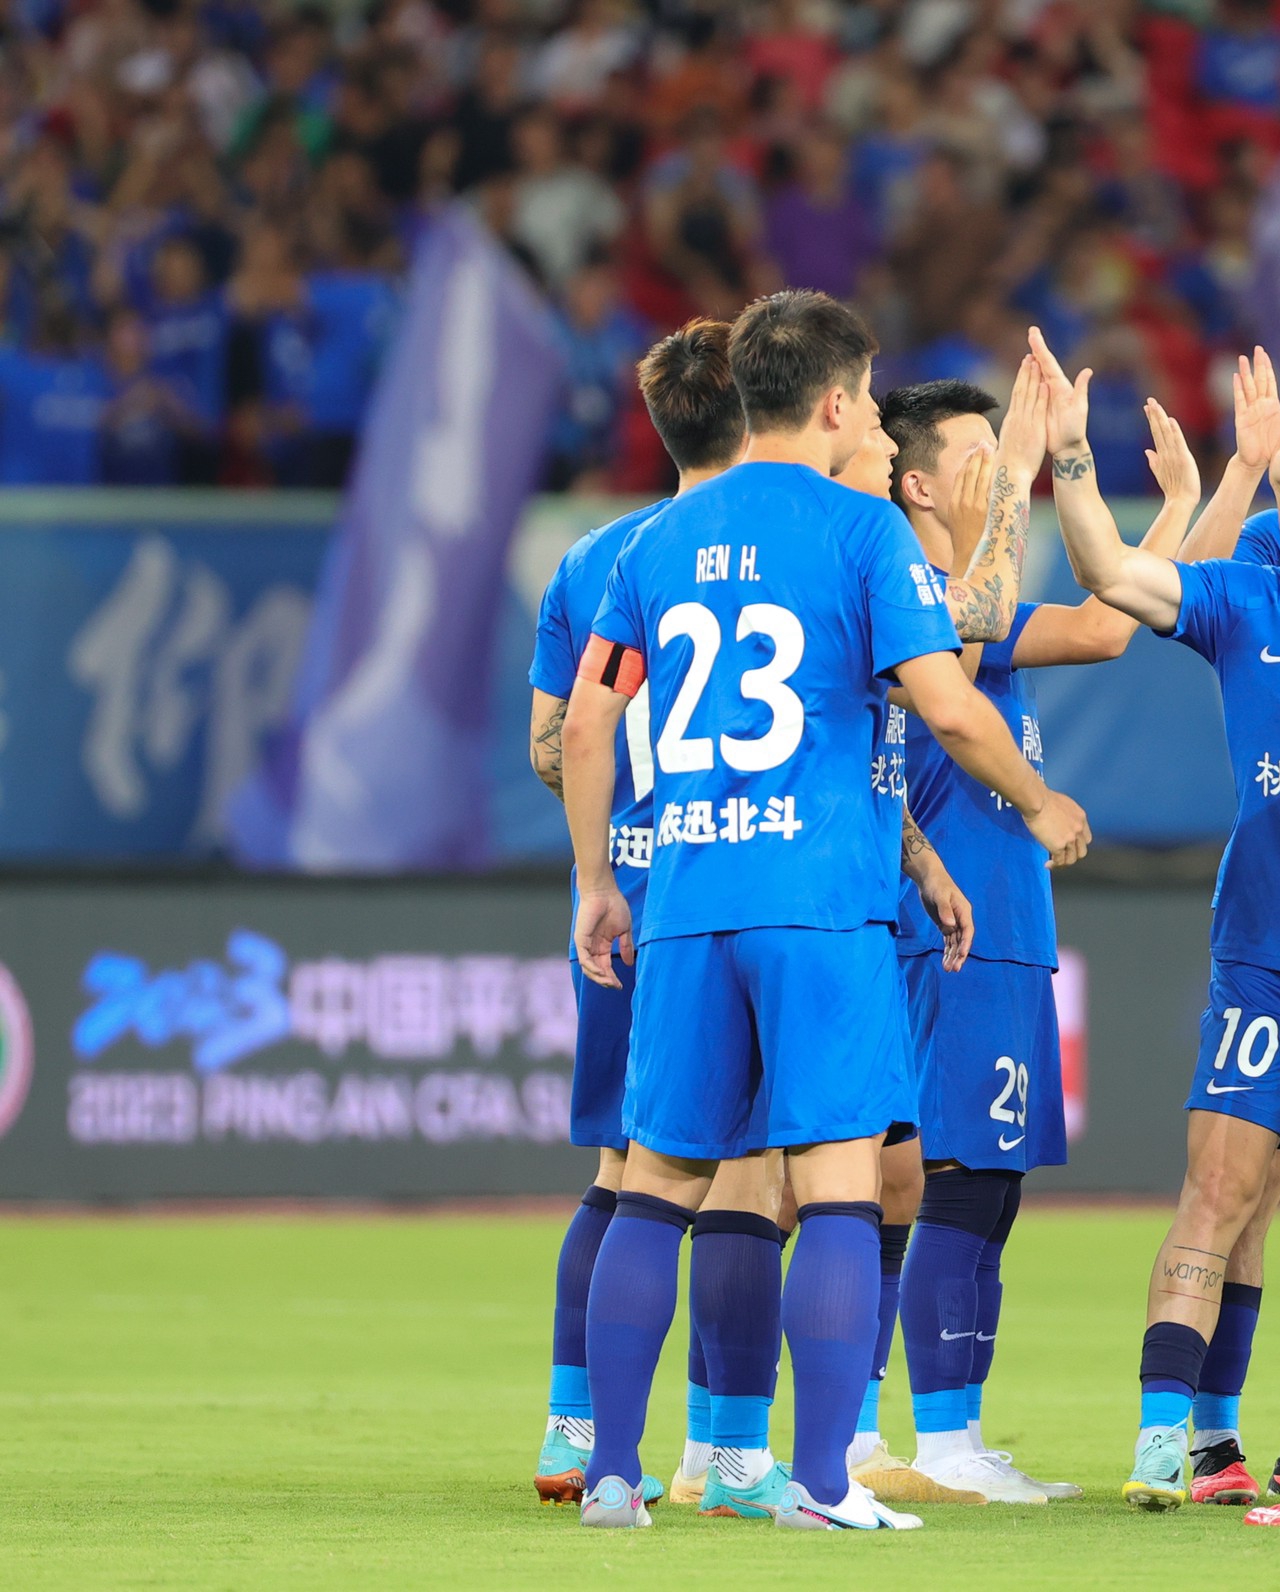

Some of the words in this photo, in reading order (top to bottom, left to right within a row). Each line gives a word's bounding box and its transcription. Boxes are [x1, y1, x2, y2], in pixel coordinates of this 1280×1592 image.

[696, 544, 730, 583] REN
[739, 545, 761, 581] H.
[656, 602, 805, 774] 23
[656, 795, 803, 847] 依迅北斗
[1214, 1007, 1279, 1077] 10
[989, 1056, 1029, 1127] 29
